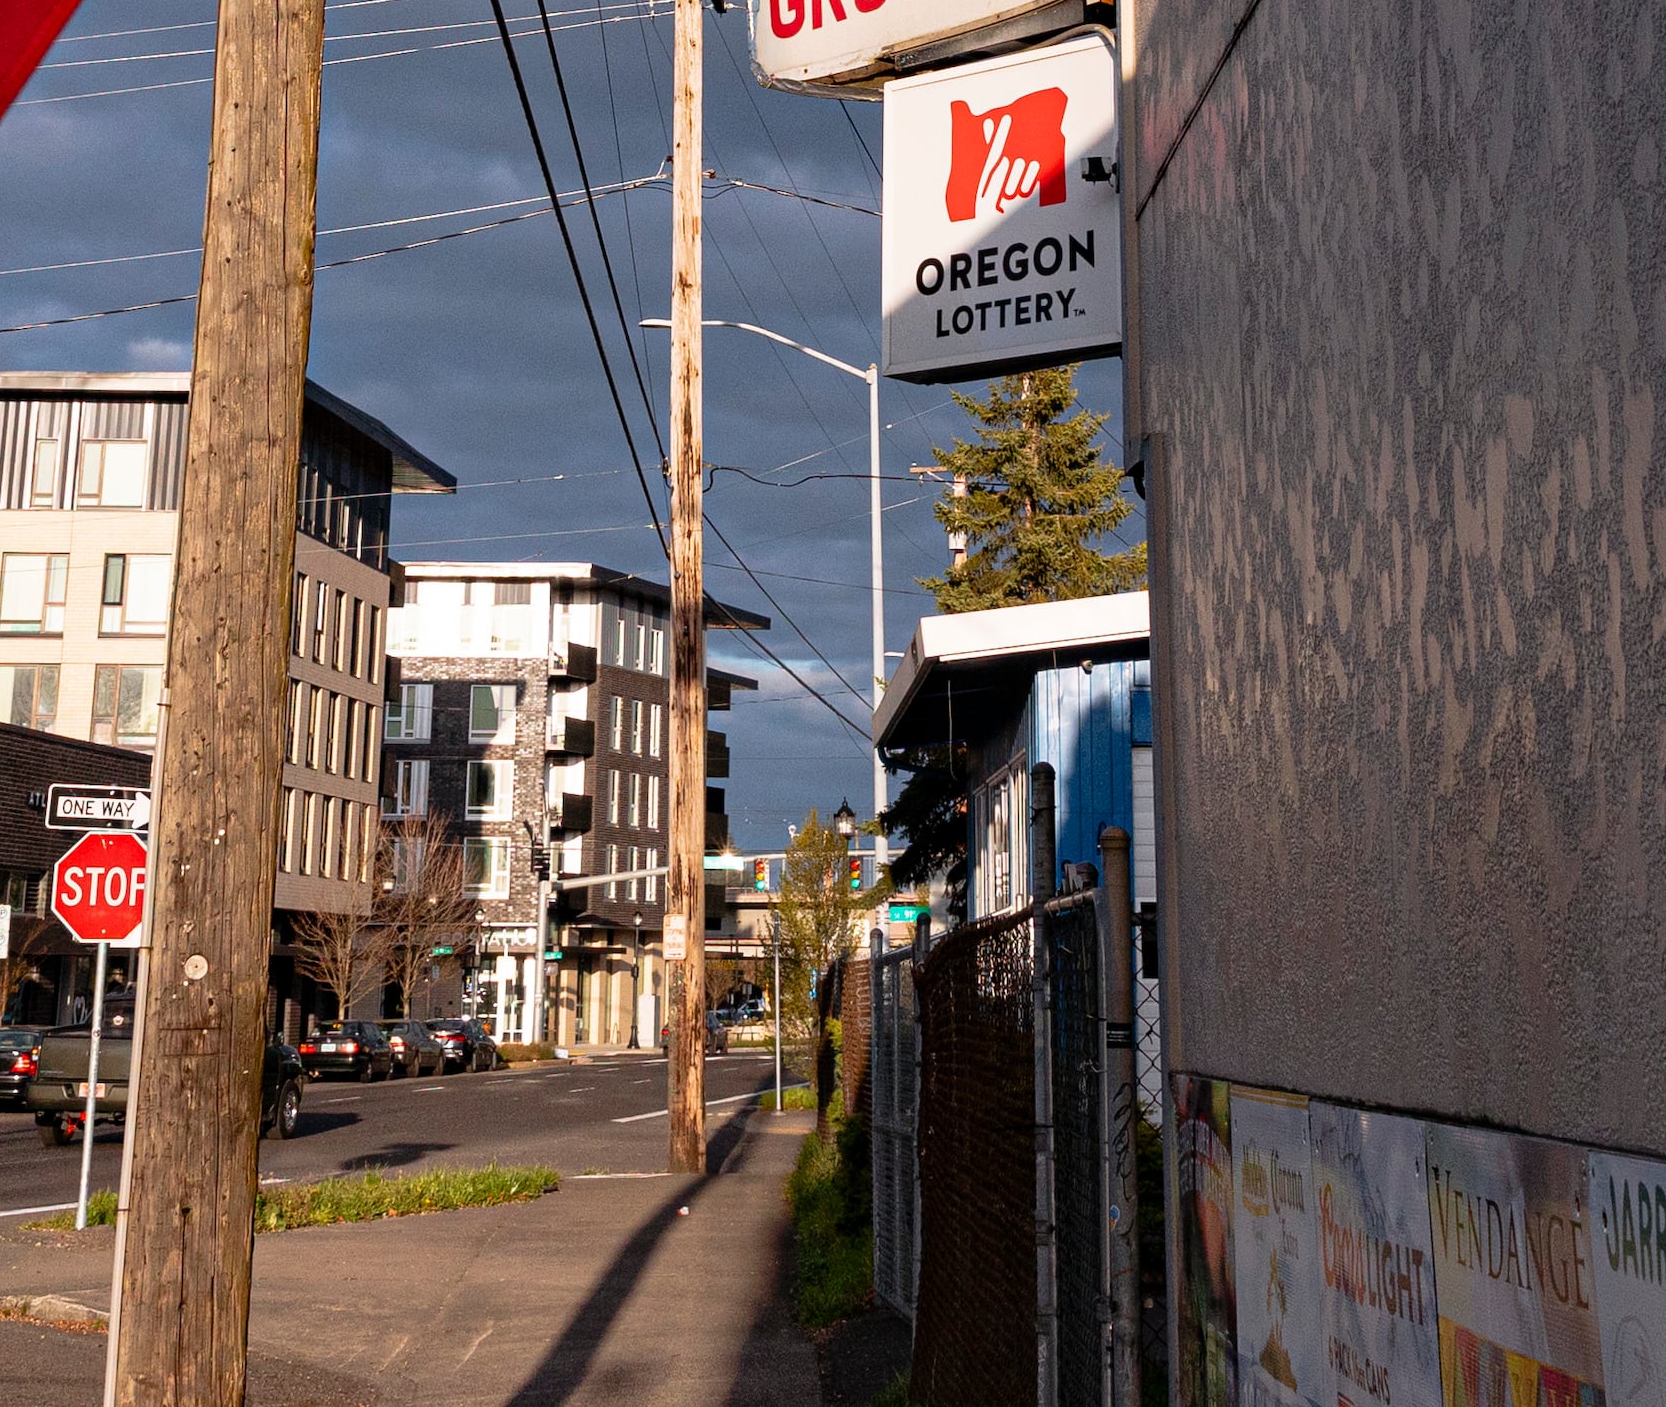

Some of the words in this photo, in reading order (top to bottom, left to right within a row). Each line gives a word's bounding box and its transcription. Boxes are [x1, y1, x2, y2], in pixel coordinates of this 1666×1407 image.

[916, 230, 1095, 296] OREGON
[62, 799, 95, 816] ONE
[102, 801, 135, 817] WAY
[61, 866, 146, 907] STOP
[1367, 1236, 1423, 1326] LIGHT
